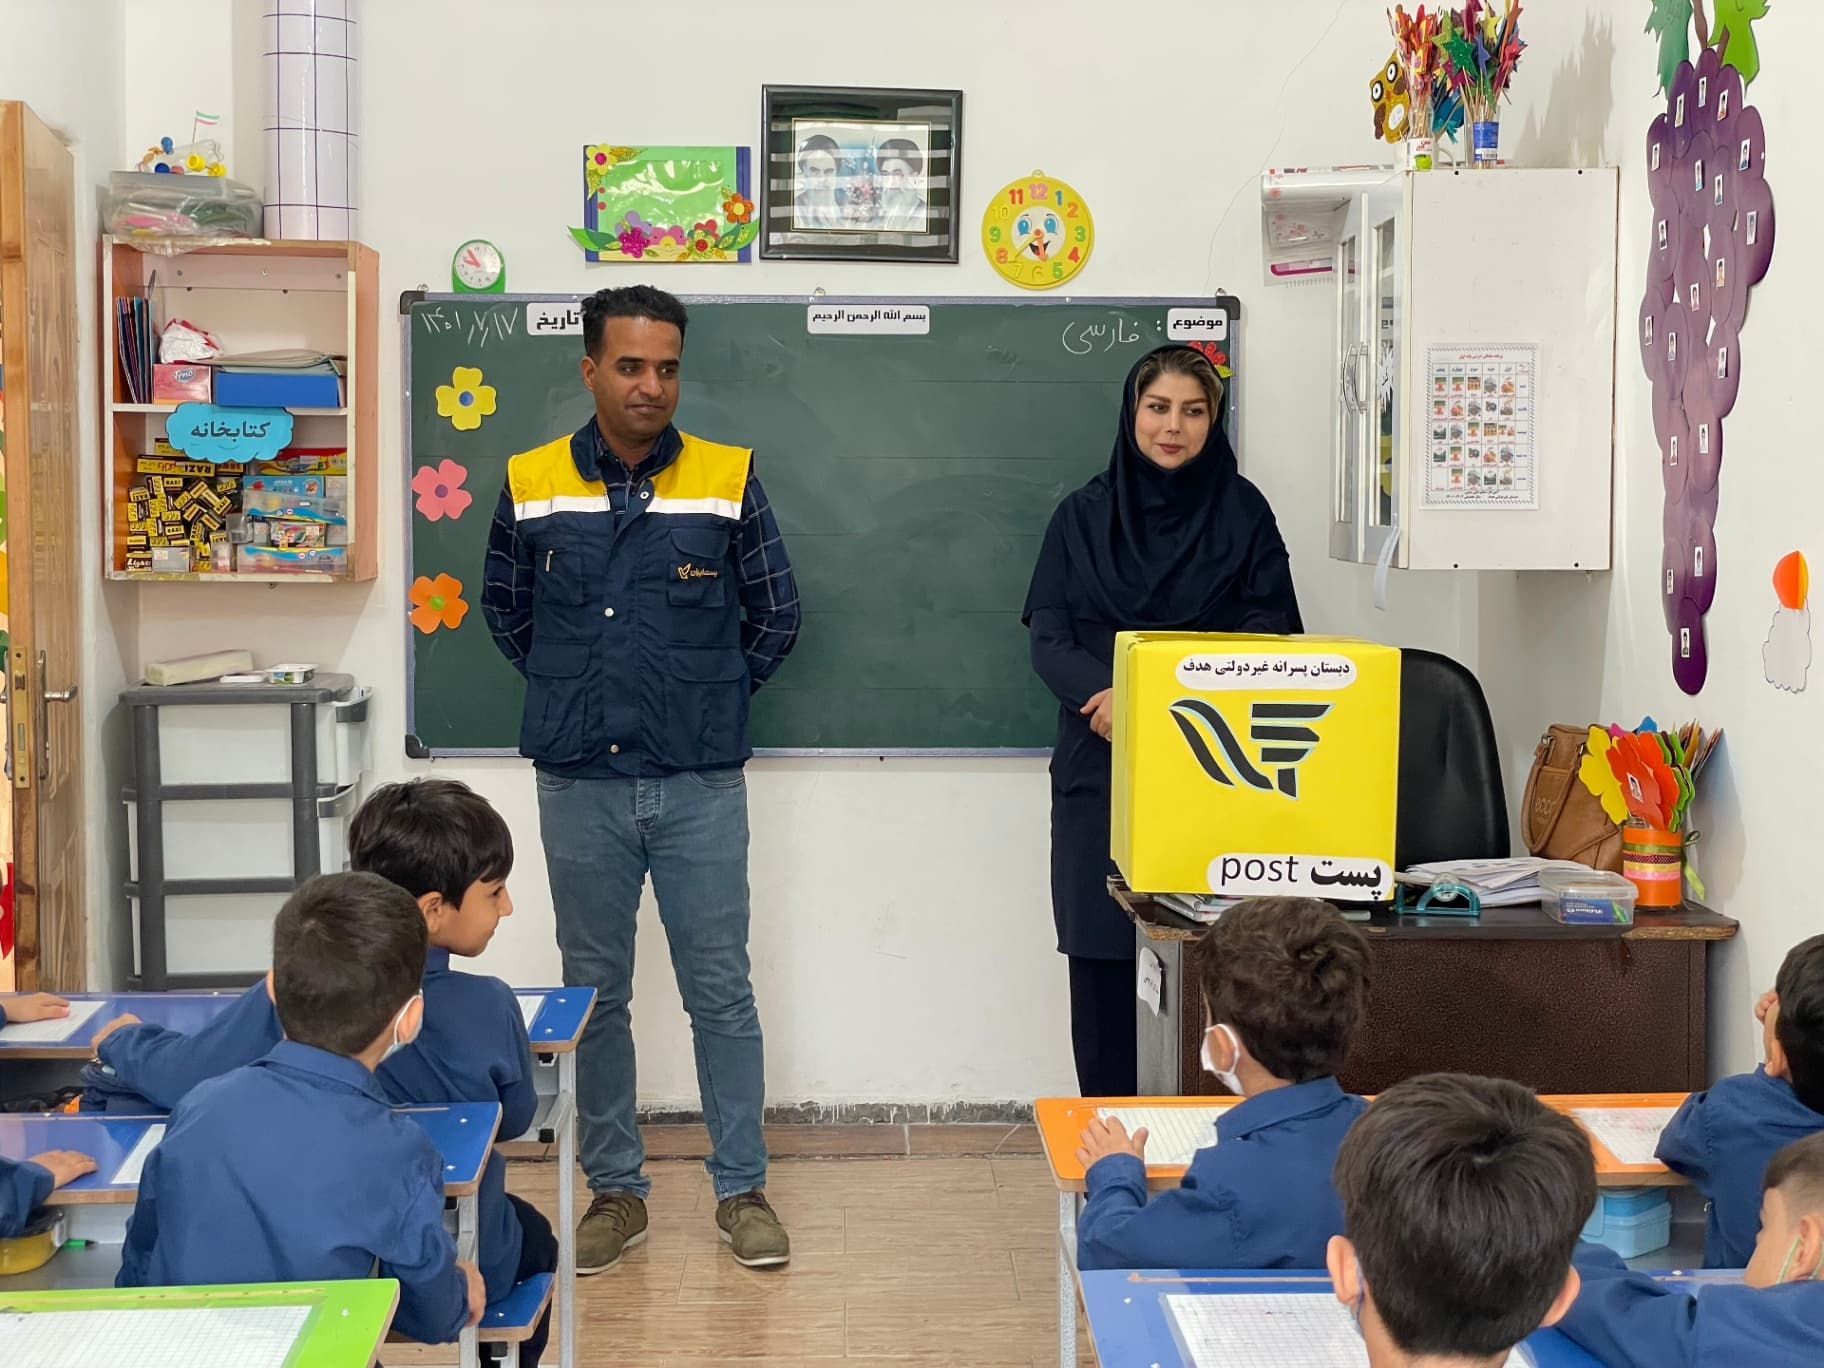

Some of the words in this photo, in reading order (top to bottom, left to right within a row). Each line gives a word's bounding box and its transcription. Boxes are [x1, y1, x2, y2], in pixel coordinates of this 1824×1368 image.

[1009, 188, 1023, 205] 11
[1029, 183, 1048, 200] 12
[1055, 190, 1063, 206] 1
[1067, 201, 1079, 218] 2
[989, 226, 1001, 242] 9
[1074, 225, 1086, 242] 3
[995, 247, 1008, 264] 8
[1068, 246, 1080, 263] 4
[1052, 261, 1064, 279] 5
[536, 309, 580, 330] تاریخ
[812, 309, 845, 322] الرحیم
[847, 309, 881, 322] الرحمن
[883, 309, 900, 320] الله
[903, 313, 926, 323] بسم
[1172, 315, 1223, 330] موضوع
[1062, 317, 1140, 355] فارسی
[190, 420, 271, 443] کتابخانه
[184, 464, 212, 474] RAZI
[1183, 658, 1212, 672] هدف
[1272, 660, 1308, 677] پسرانه
[1310, 661, 1350, 677] دبستان
[1221, 855, 1299, 887] post
[1310, 859, 1382, 901] پست
